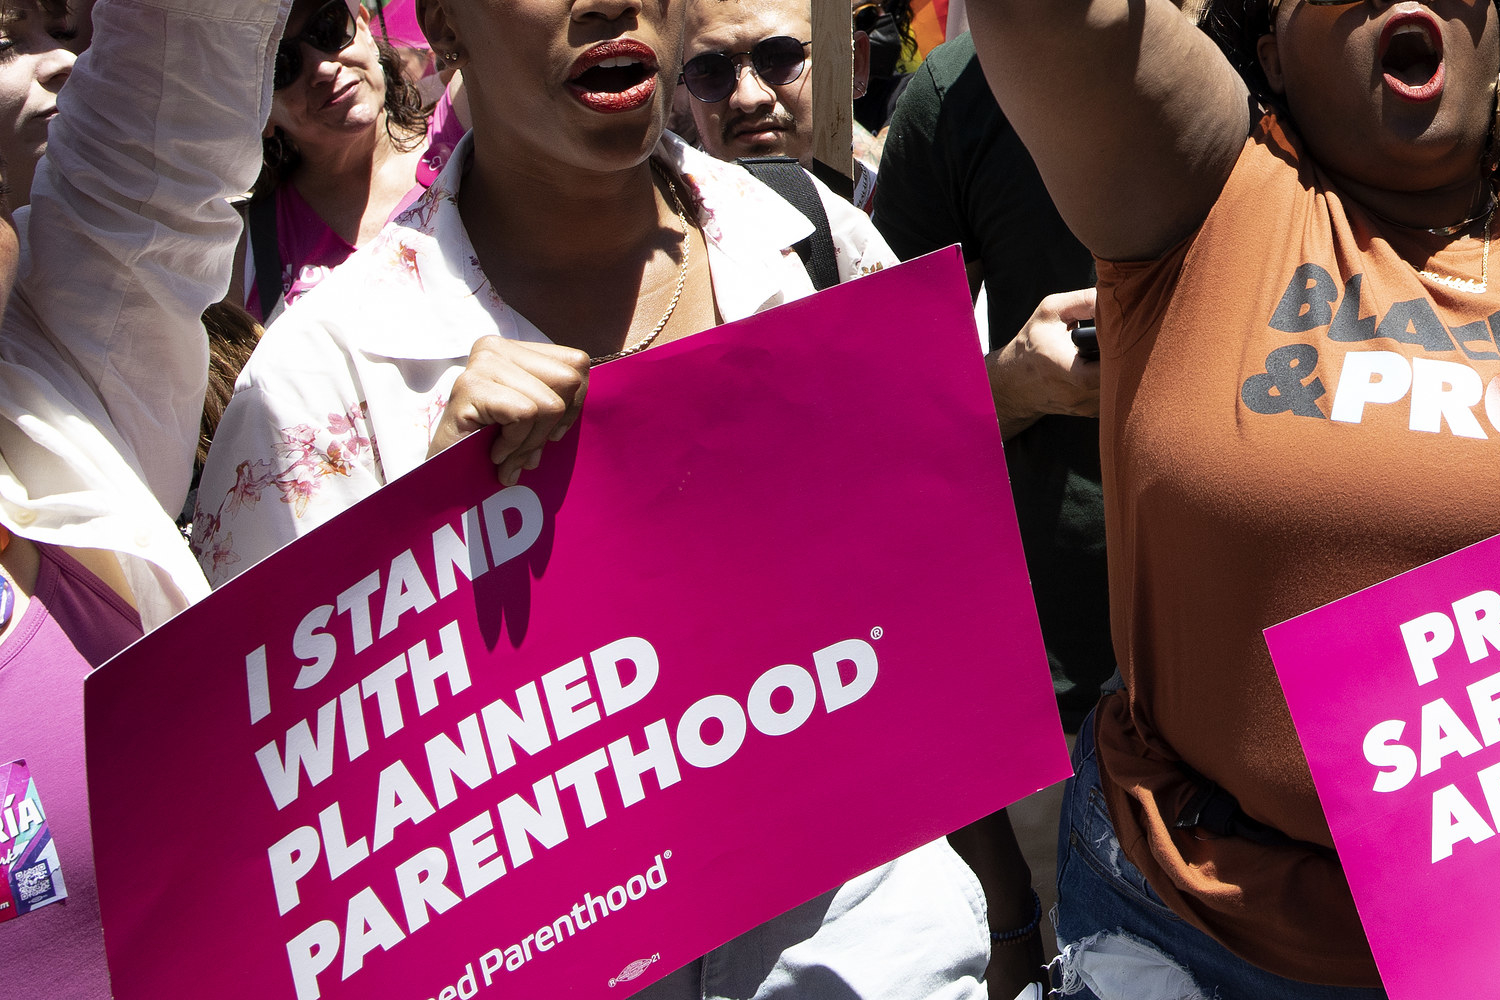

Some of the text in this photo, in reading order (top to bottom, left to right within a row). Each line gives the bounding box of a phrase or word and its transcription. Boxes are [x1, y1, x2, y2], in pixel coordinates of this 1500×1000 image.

[1241, 343, 1327, 420] &
[246, 485, 543, 725] I STAND
[255, 620, 472, 810] WITH
[268, 637, 659, 916] PLANNED
